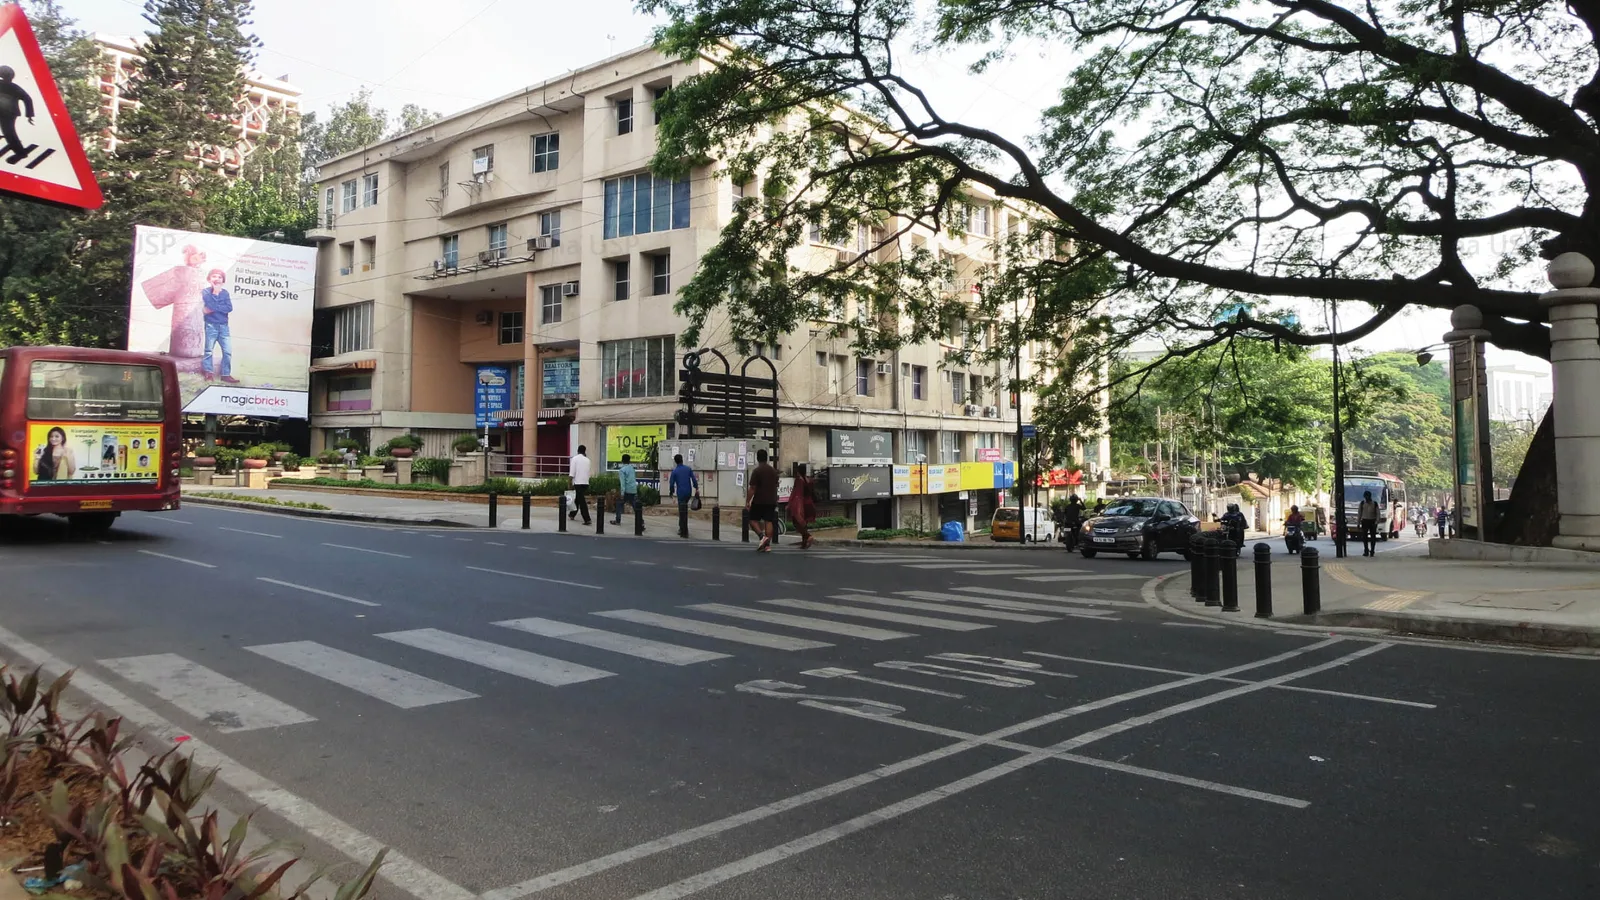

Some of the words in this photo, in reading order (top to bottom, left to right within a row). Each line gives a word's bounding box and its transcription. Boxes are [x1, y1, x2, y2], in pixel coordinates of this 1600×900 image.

[234, 274, 266, 286] India's
[267, 278, 289, 289] No.1
[234, 285, 279, 300] Property
[280, 290, 299, 301] Site
[544, 362, 573, 370] REALTORS
[220, 394, 286, 407] magicbricks
[616, 435, 657, 449] TO-LET
